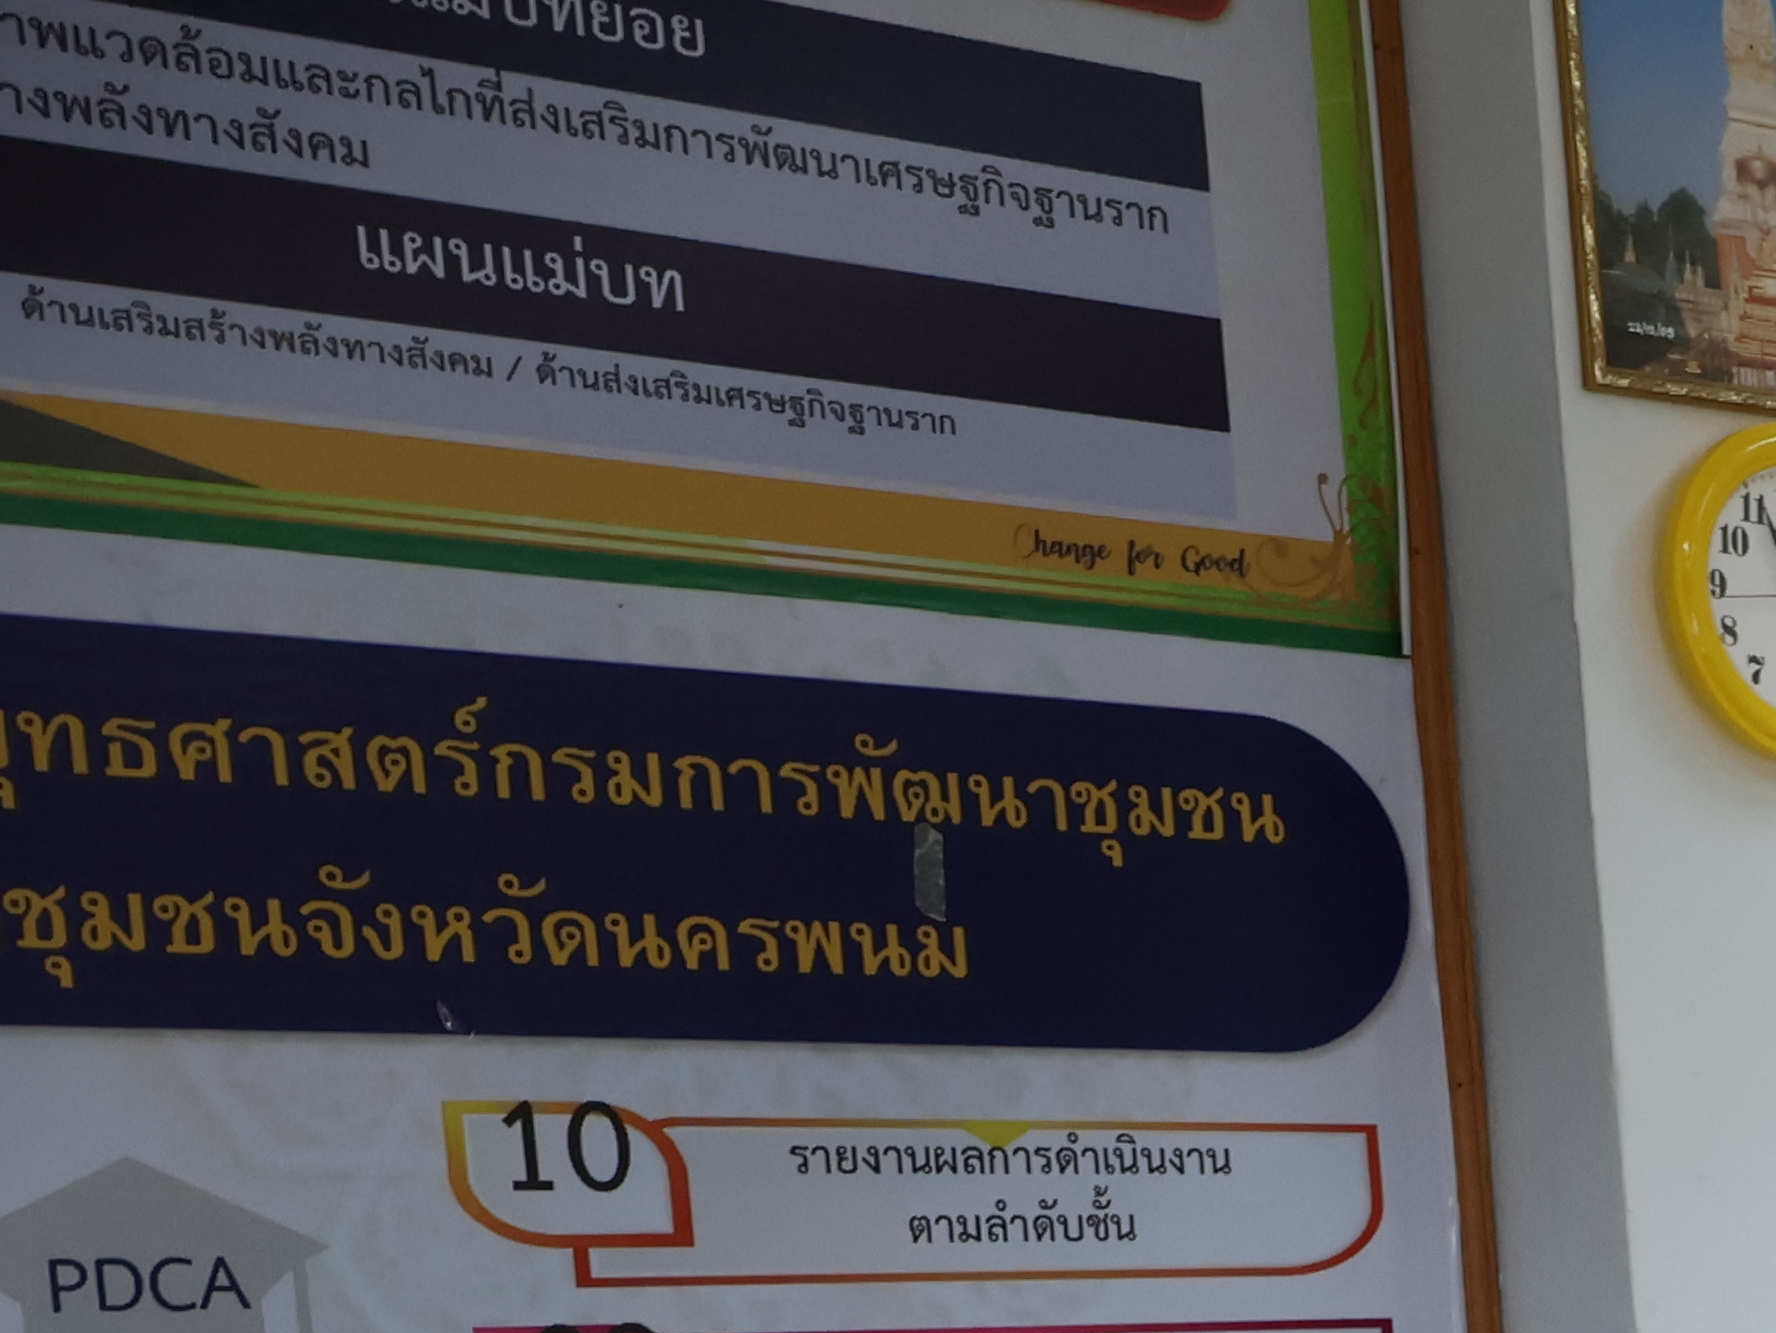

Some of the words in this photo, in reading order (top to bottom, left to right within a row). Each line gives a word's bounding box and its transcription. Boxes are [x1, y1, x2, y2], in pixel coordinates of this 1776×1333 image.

[355, 224, 685, 312] แผนแม่บท
[21, 285, 494, 379] ด้านเสริมสร้างพลังทางสังคม
[535, 351, 957, 437] ด้านส่งเสริมเศรษฐกิจฐานราก
[1741, 491, 1766, 525] 11
[1012, 522, 1112, 569] Change
[1126, 537, 1165, 576] for
[1179, 545, 1250, 579] Good
[1718, 524, 1750, 556] 10
[1710, 569, 1727, 600] 9
[1721, 615, 1738, 646] 8
[1748, 655, 1765, 685] 7
[0, 696, 1287, 867] ุทธศาสตร์กรมการพัฒนาชุมชน
[1, 864, 970, 988] ชุมชนจังหวัดนครพนม
[500, 1098, 633, 1196] 10
[788, 1131, 1233, 1178] รายงานผลการดำเนินงาน
[908, 1184, 1138, 1246] ตามลำดับชั้น
[48, 1256, 252, 1313] PDCA
